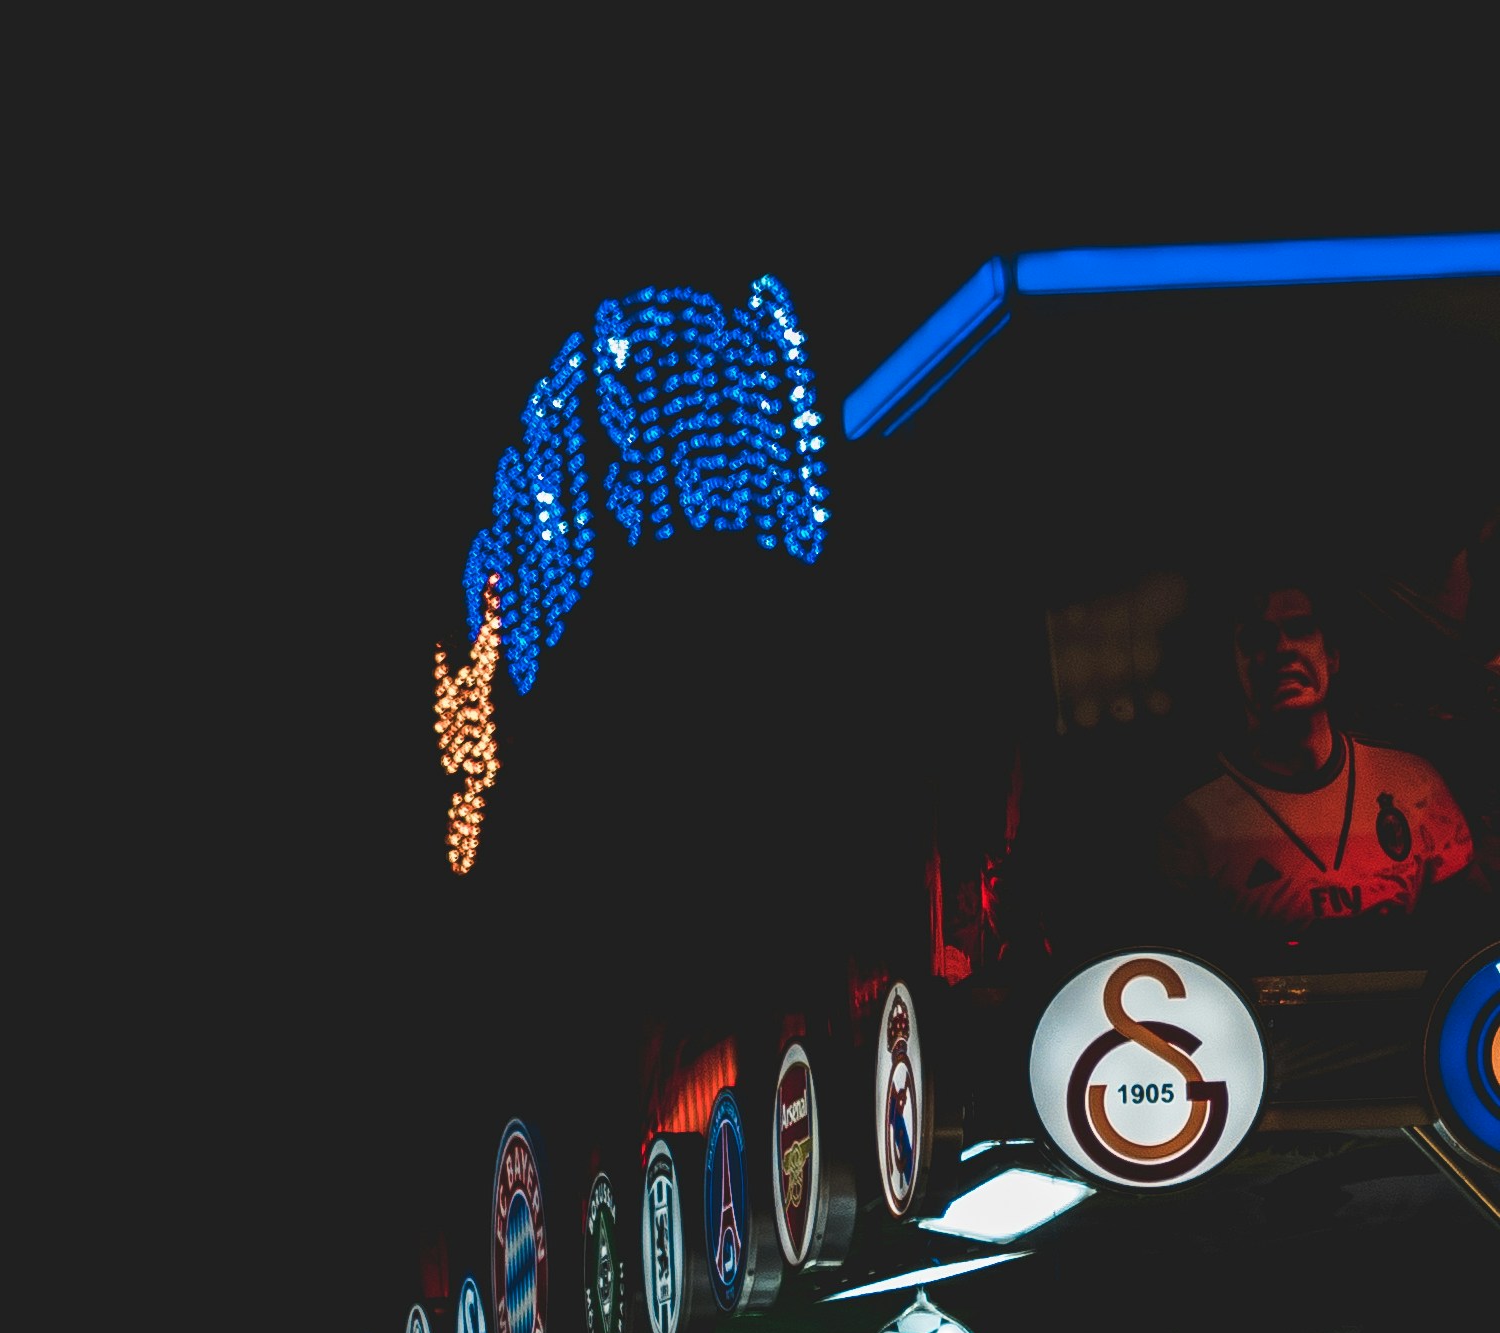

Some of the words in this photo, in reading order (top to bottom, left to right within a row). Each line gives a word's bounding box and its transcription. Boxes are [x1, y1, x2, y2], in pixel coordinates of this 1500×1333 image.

[1117, 1082, 1175, 1104] 1905
[780, 1095, 809, 1131] Arsenal
[506, 1145, 546, 1264] BAYERN
